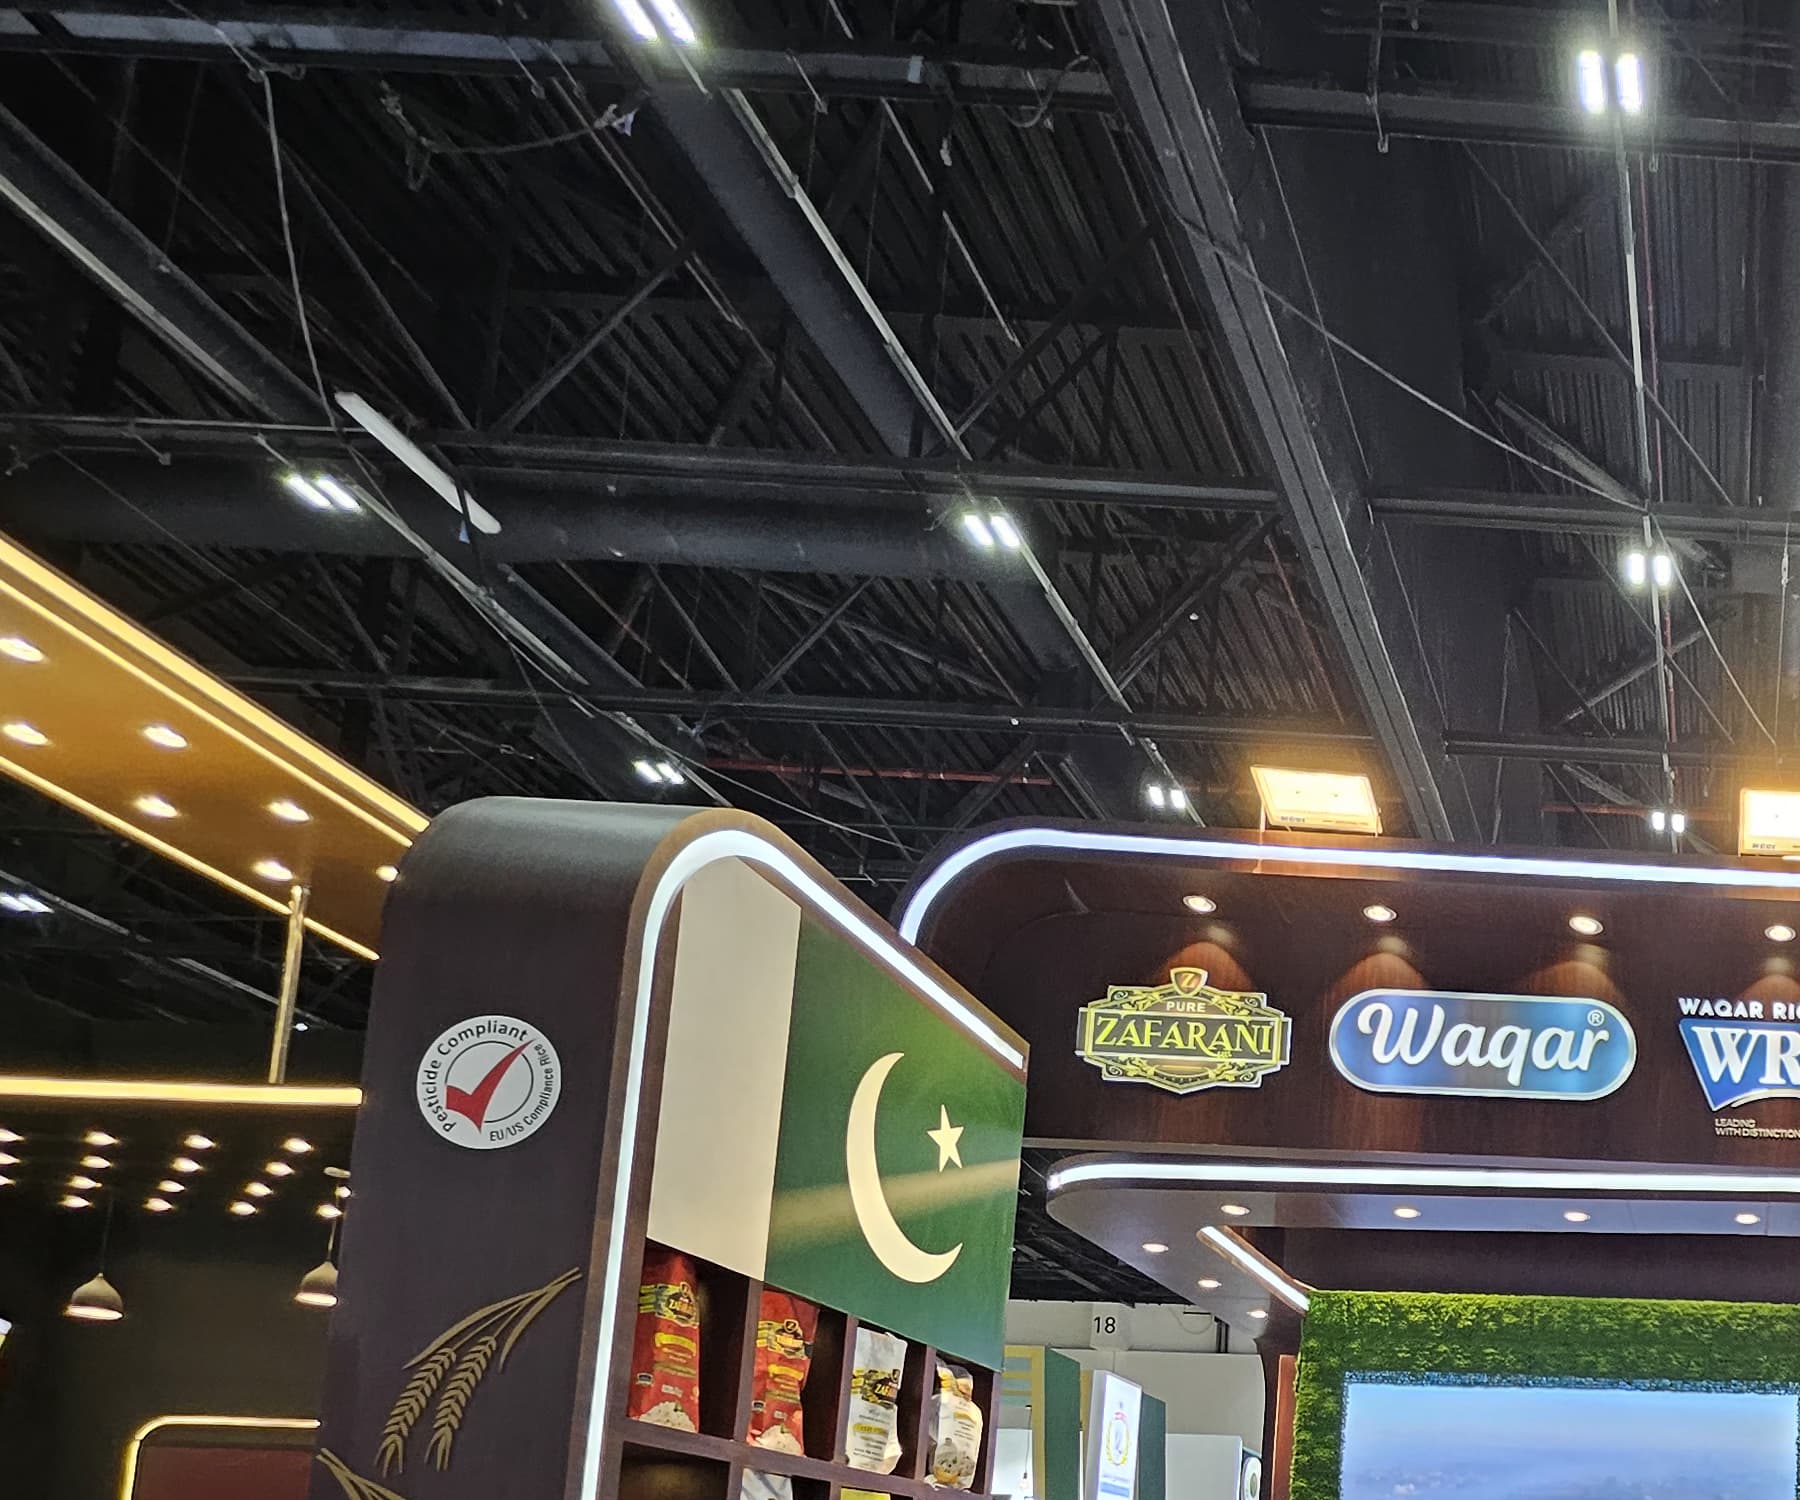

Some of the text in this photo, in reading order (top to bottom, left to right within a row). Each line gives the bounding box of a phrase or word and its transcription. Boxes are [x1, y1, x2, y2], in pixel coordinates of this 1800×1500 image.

[1166, 1000, 1207, 1014] PURE
[1679, 997, 1765, 1020] WAQAR
[1095, 1014, 1273, 1058] ZAFARANI
[1358, 1002, 1609, 1086] Waqar
[422, 1020, 528, 1133] Pesticide Compliant
[490, 1043, 553, 1142] EU/US Compliance Rice
[1715, 1118, 1756, 1129] LEADING
[1715, 1127, 1742, 1138] WITH
[1093, 1316, 1116, 1334] 18
